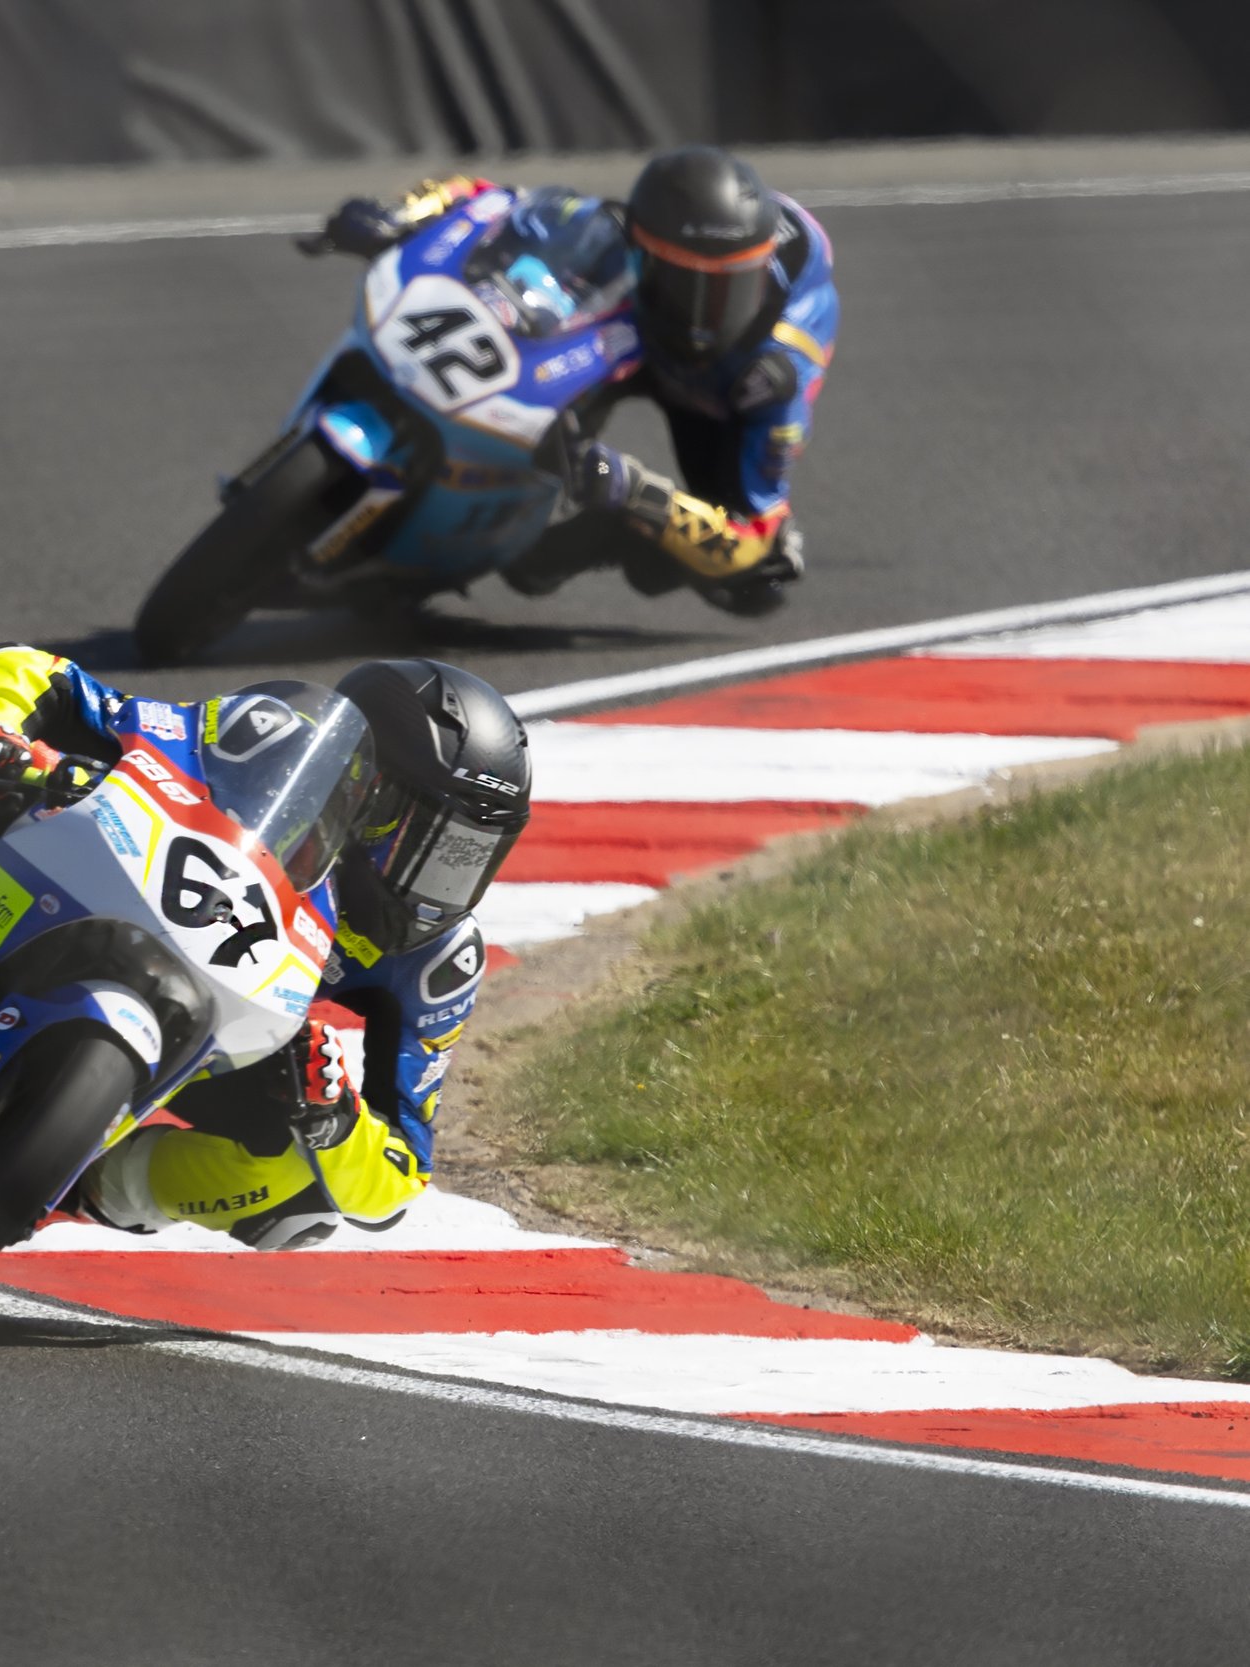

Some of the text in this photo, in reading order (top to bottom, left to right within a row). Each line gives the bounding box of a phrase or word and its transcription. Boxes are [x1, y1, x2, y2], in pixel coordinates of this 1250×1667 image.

[403, 305, 508, 398] 42
[121, 749, 203, 806] GB 67
[452, 767, 520, 797] LS2
[161, 836, 279, 969] 67
[178, 1184, 270, 1216] REV'IT!
